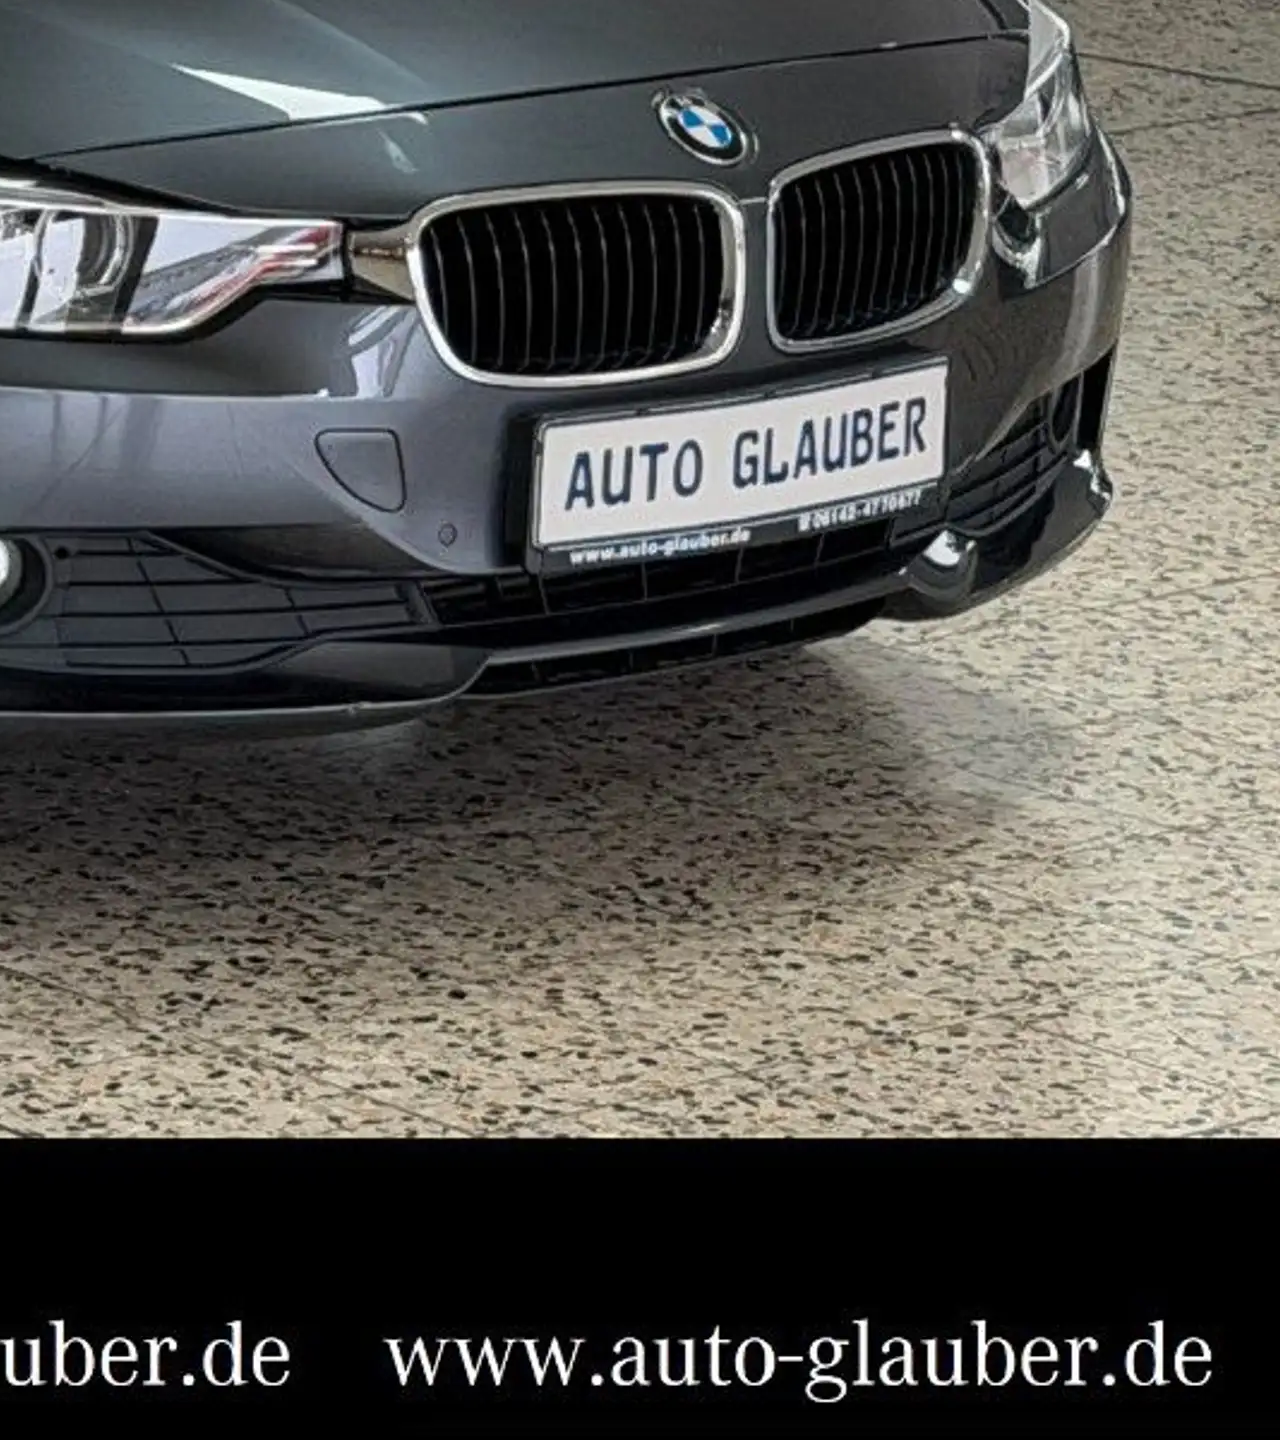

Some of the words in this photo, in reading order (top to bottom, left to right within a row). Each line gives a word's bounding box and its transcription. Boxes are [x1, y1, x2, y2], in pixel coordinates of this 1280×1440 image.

[564, 439, 704, 511] AUTO
[731, 396, 928, 488] GLAUBER
[569, 526, 752, 566] www.auto-glauber.de
